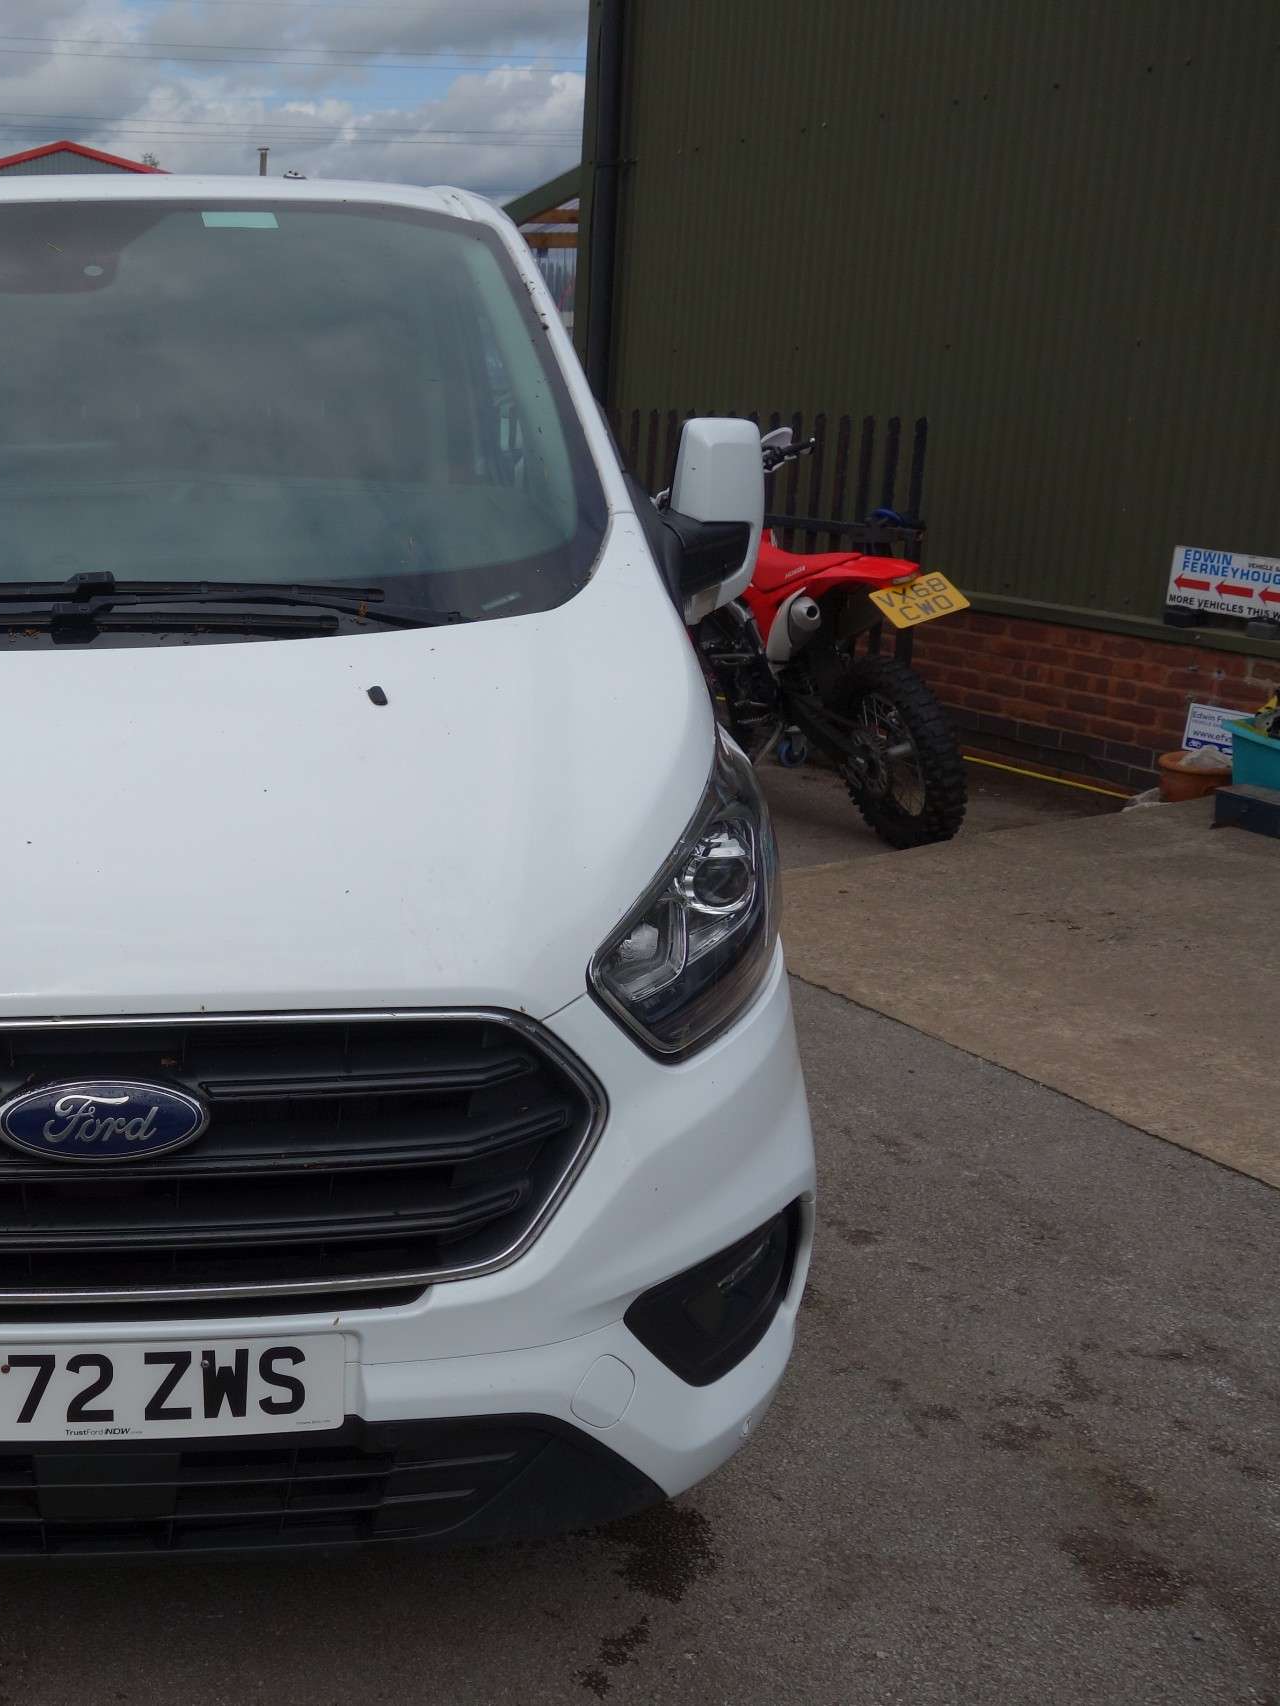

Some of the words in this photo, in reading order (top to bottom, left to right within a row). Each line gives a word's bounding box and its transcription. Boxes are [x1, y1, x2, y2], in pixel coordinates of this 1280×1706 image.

[1184, 549, 1232, 565] EDWIN
[876, 577, 947, 608] VX68
[1169, 594, 1194, 606] MORE
[1198, 598, 1244, 613] VEHICLES
[1247, 607, 1271, 618] THIS
[42, 1094, 158, 1142] Ford
[144, 1346, 306, 1420] ZWS
